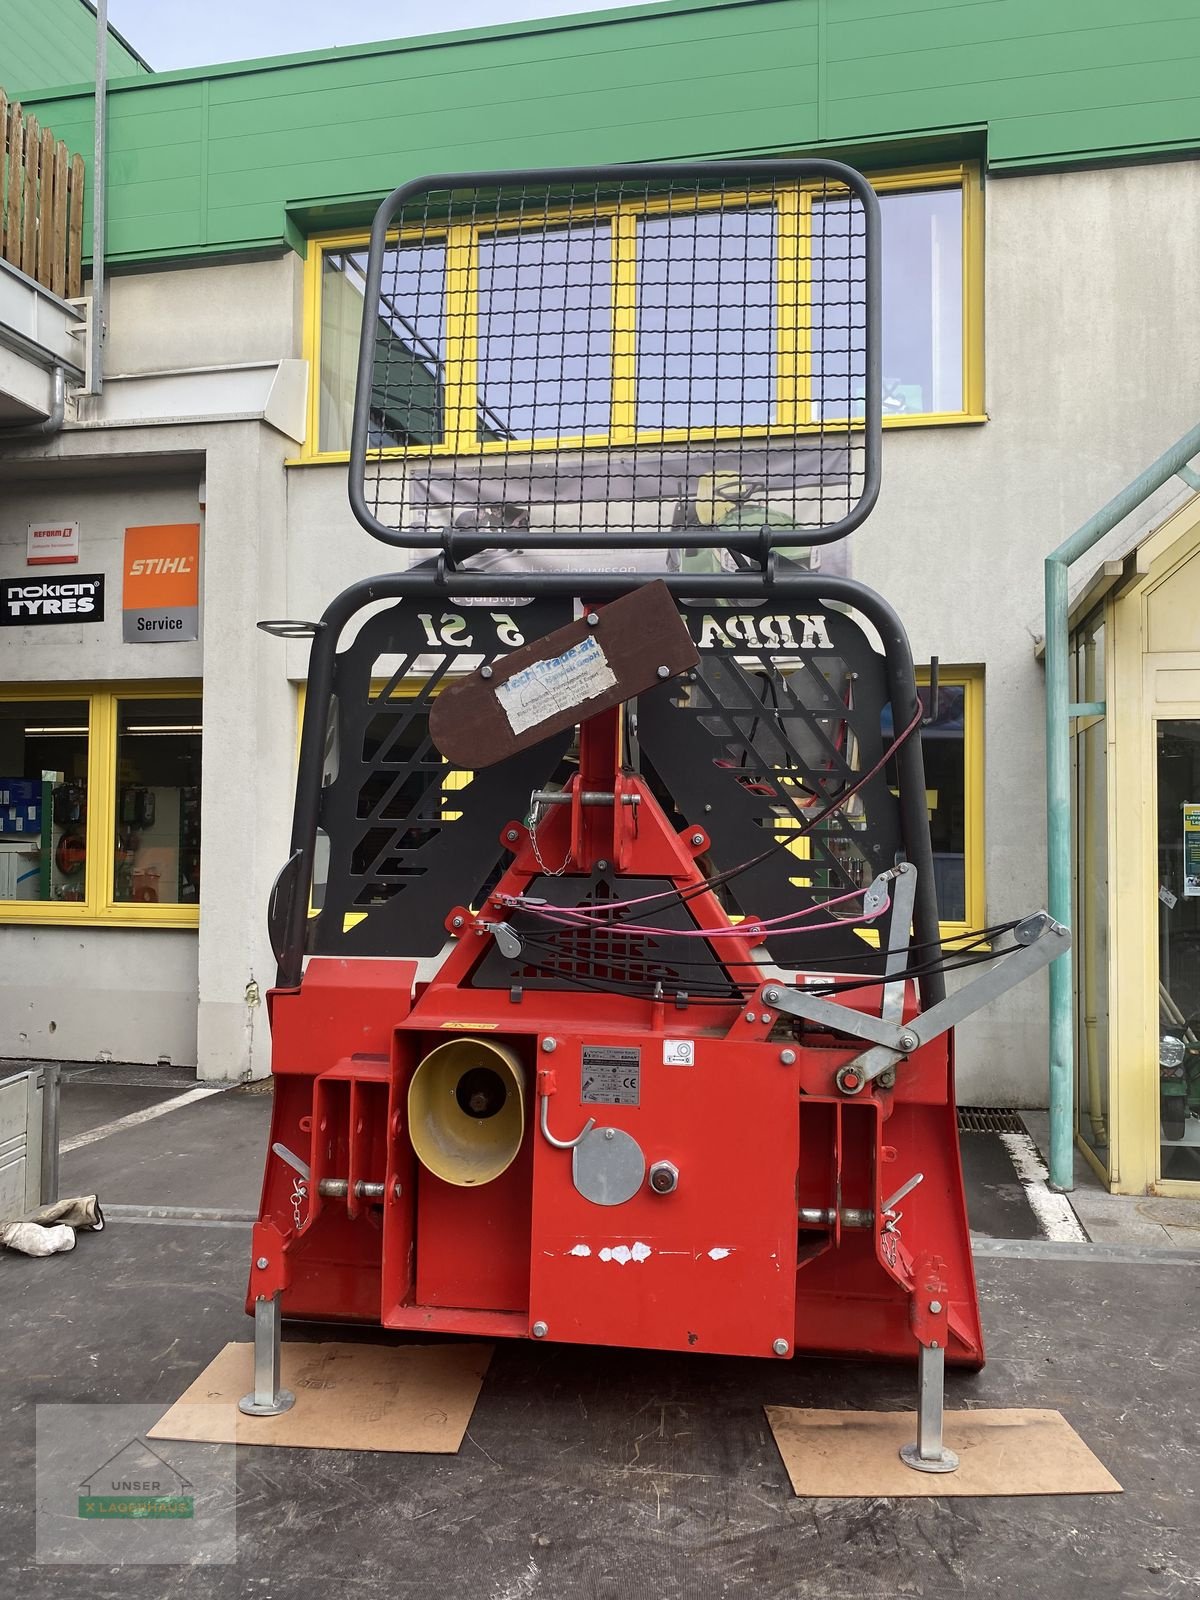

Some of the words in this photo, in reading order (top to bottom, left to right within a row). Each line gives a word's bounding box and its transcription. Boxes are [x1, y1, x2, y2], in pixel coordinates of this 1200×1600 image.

[33, 530, 62, 538] REFORM
[129, 557, 191, 576] STIHL
[8, 597, 95, 616] TYRES
[137, 616, 183, 631] Service
